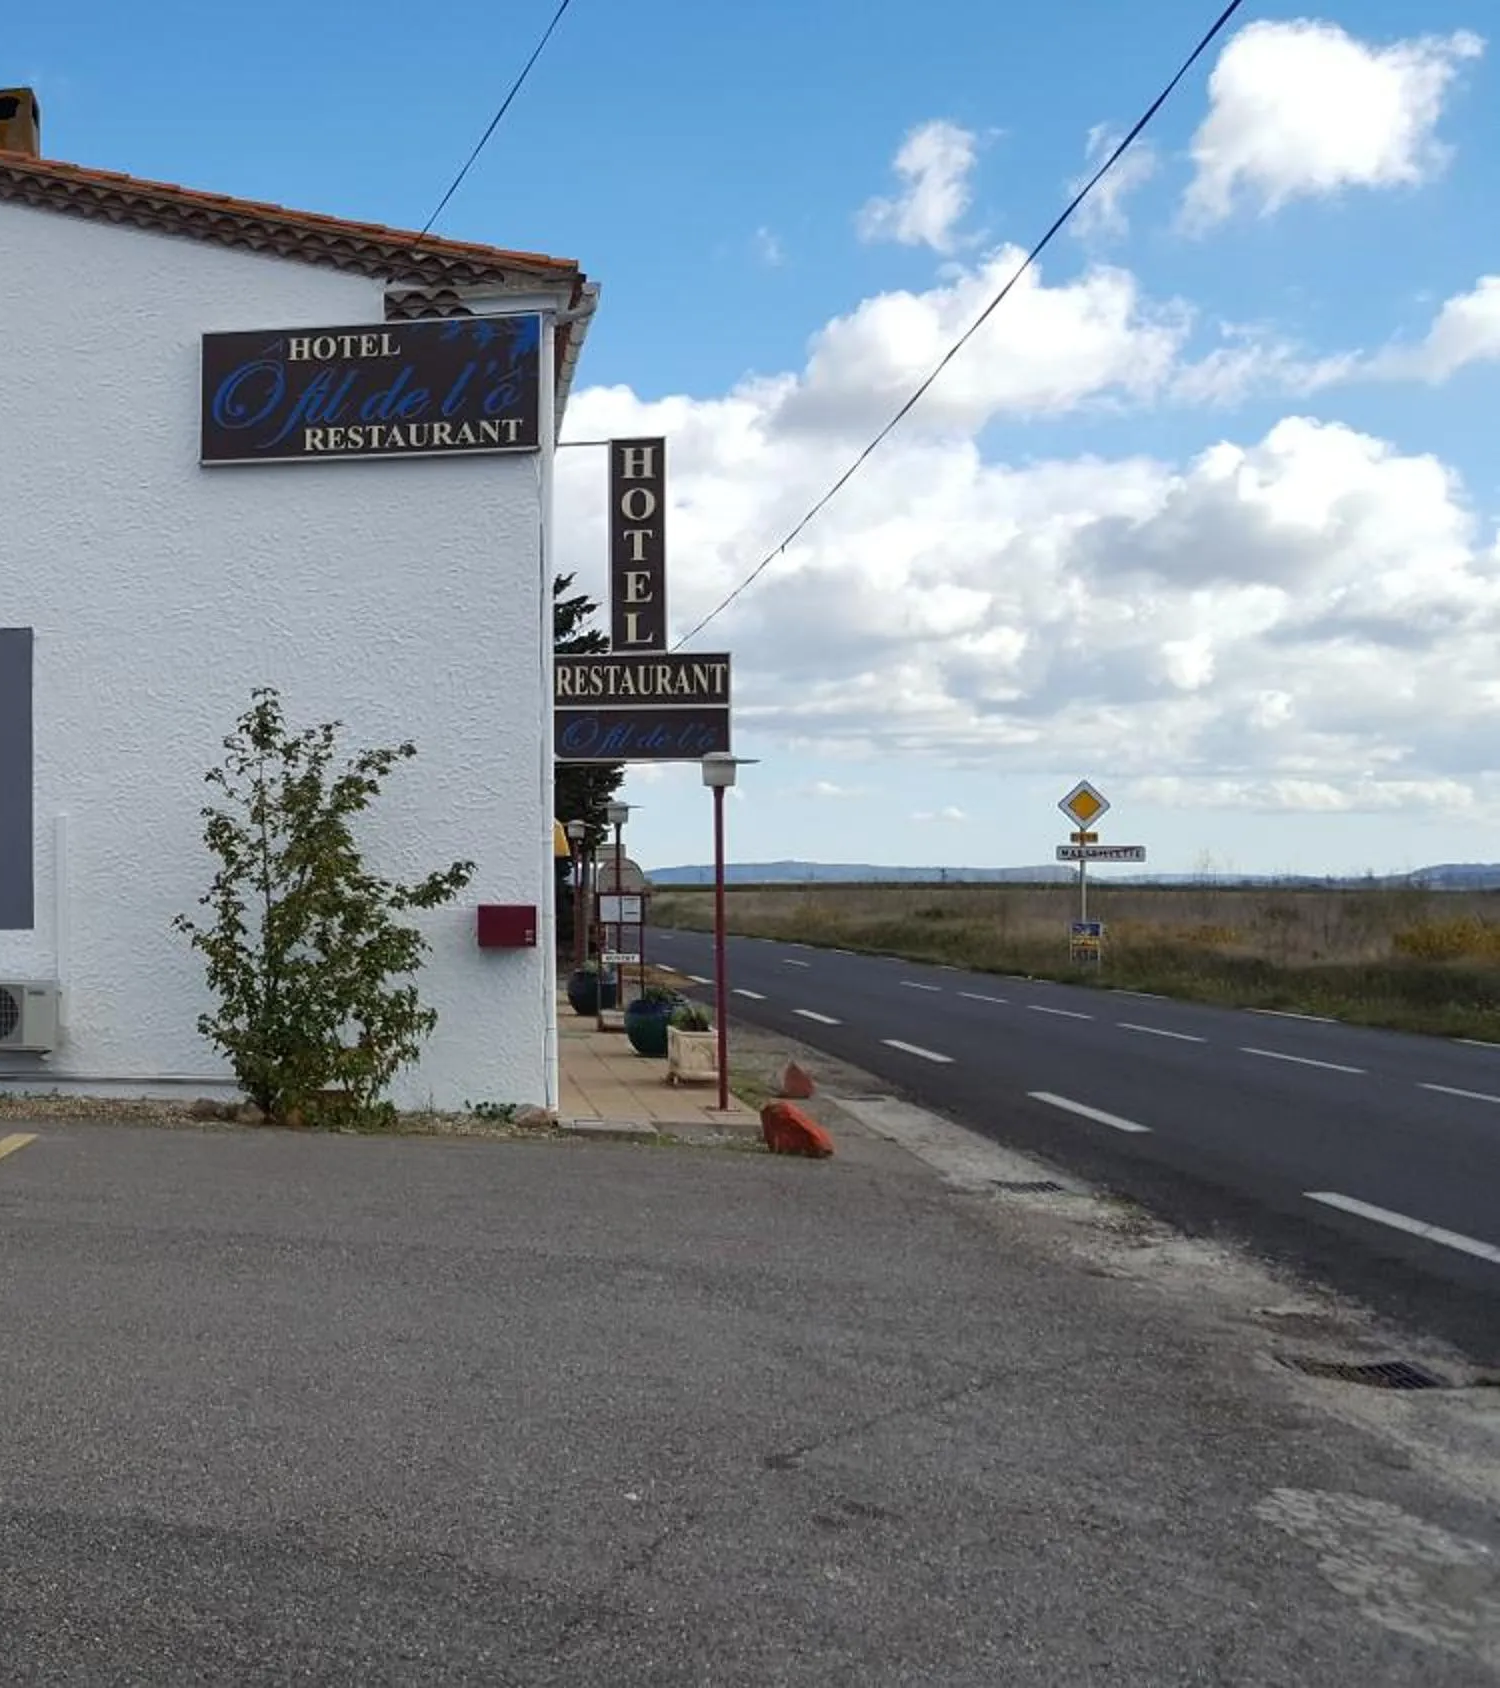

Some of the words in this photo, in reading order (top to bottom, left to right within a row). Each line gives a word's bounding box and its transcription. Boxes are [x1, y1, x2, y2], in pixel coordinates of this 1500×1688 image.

[288, 333, 401, 361] HOTEL
[359, 366, 431, 422] de
[303, 419, 524, 451] RESTAURANT
[619, 446, 656, 645] HOTEL
[556, 663, 728, 697] RESTAURANT
